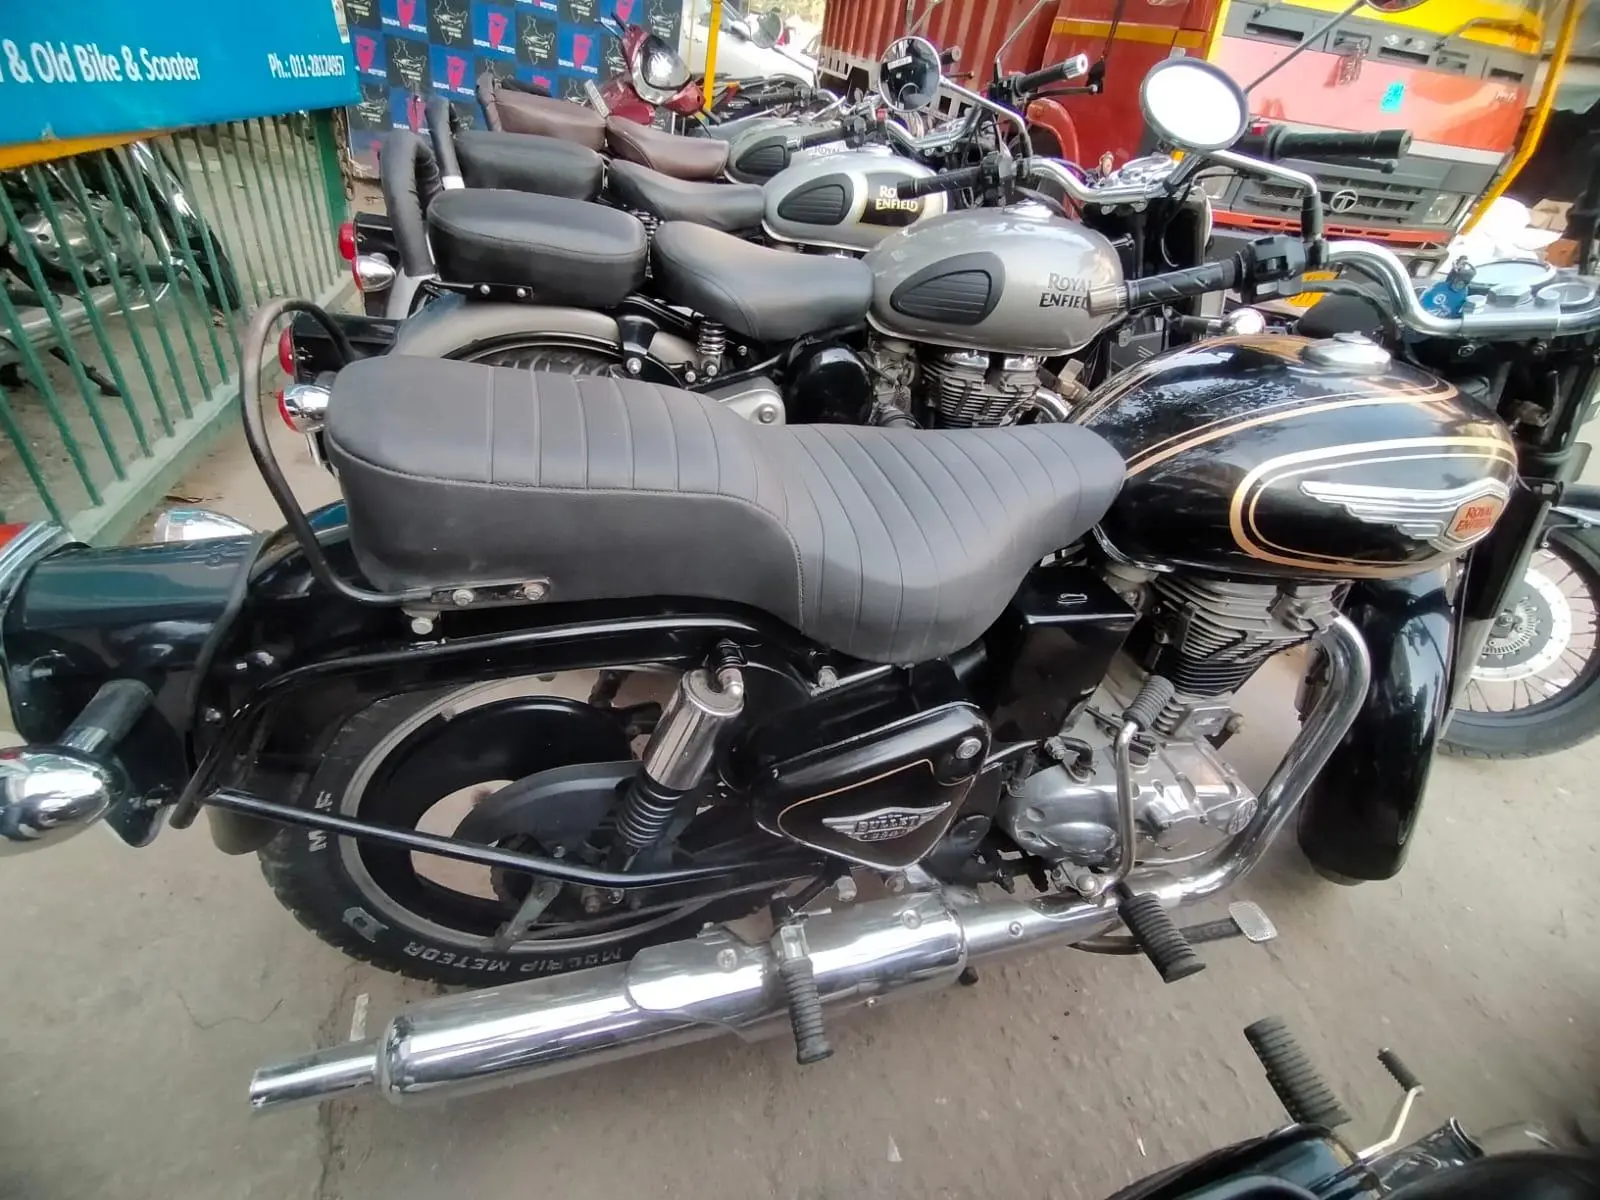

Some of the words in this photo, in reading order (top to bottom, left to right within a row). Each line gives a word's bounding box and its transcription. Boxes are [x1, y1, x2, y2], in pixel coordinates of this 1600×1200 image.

[3, 38, 34, 83] &
[30, 41, 77, 83] Old
[73, 43, 123, 82] Bike
[121, 45, 143, 81] &
[139, 48, 200, 81] Scooter
[875, 198, 918, 212] ENFIELD
[1039, 292, 1089, 310] ENFIEL
[403, 941, 510, 973] METEOR
